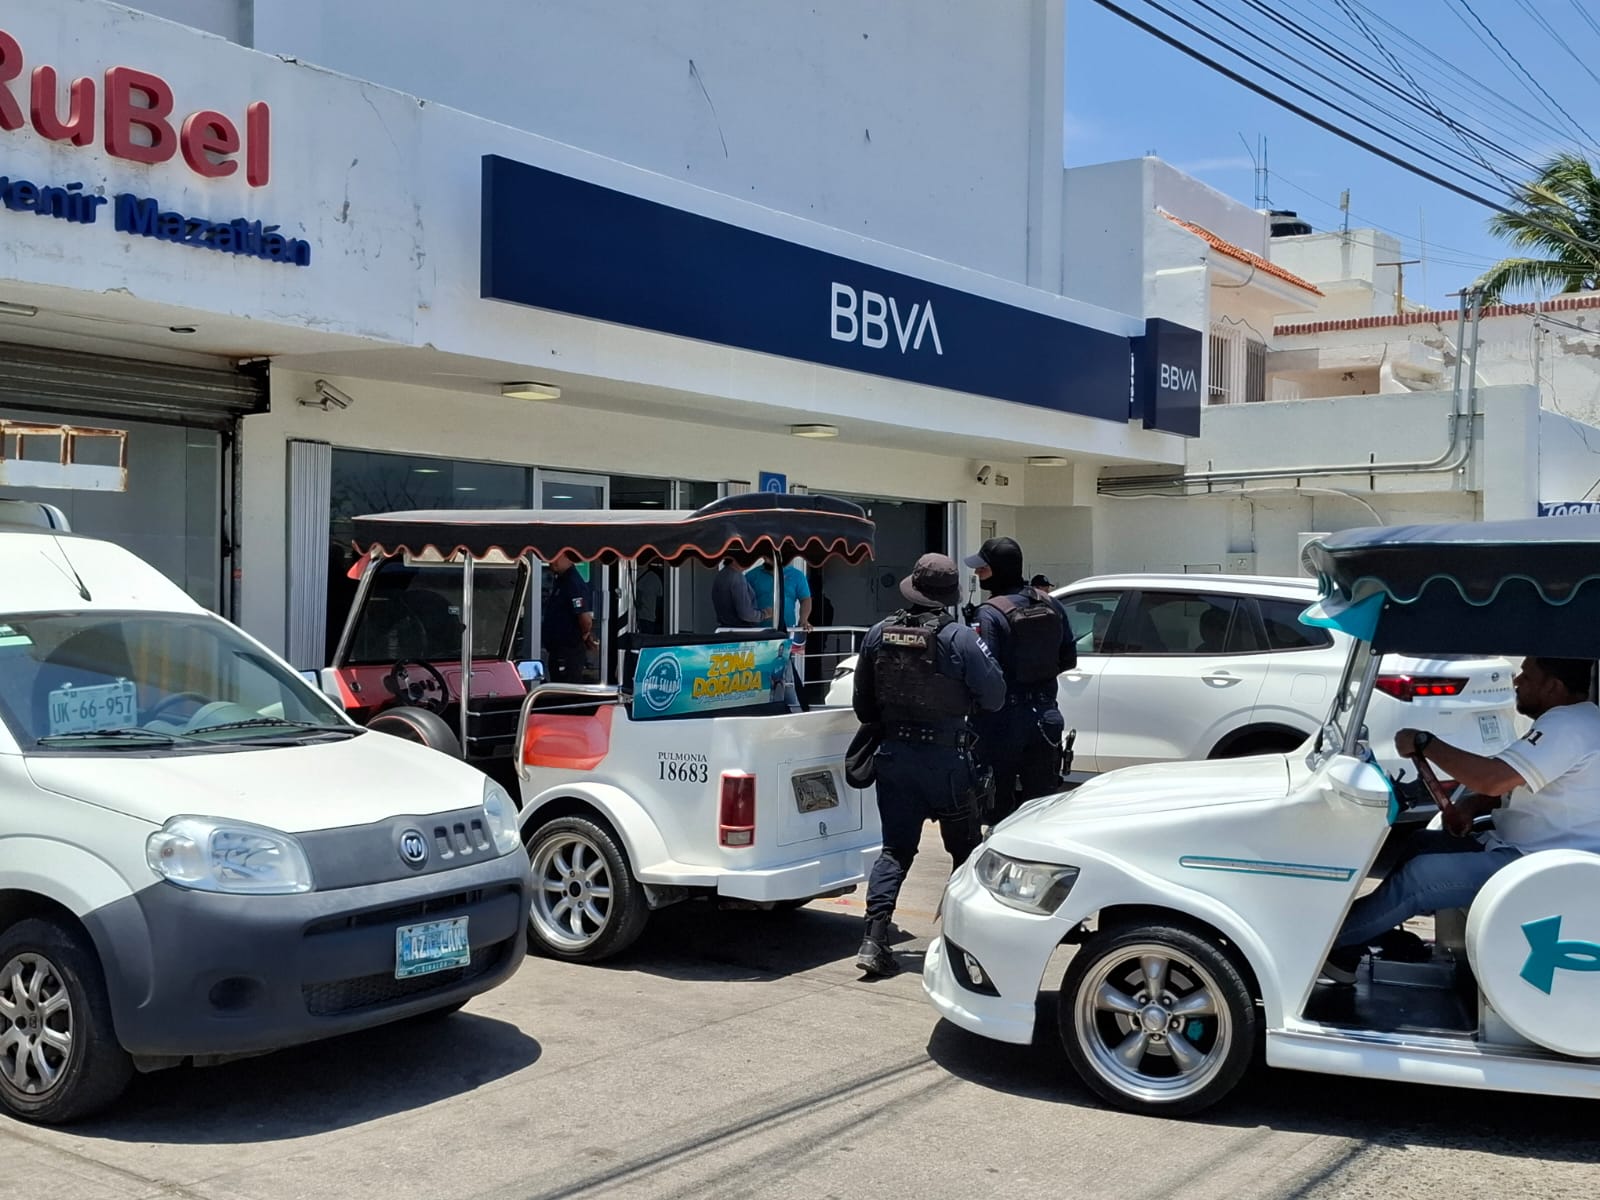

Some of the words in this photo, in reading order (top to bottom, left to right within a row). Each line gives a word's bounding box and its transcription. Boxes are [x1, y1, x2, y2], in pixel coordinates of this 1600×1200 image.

[0, 175, 108, 225] enir
[114, 192, 312, 267] Mazatlán
[830, 282, 943, 355] BBVA
[1160, 362, 1198, 393] BBVA
[882, 632, 927, 646] POLICIA
[708, 652, 755, 677] ZONA
[693, 671, 762, 698] DORADA
[52, 695, 132, 723] UK-66-957
[658, 751, 708, 762] PULMONIA
[659, 761, 708, 784] 18683
